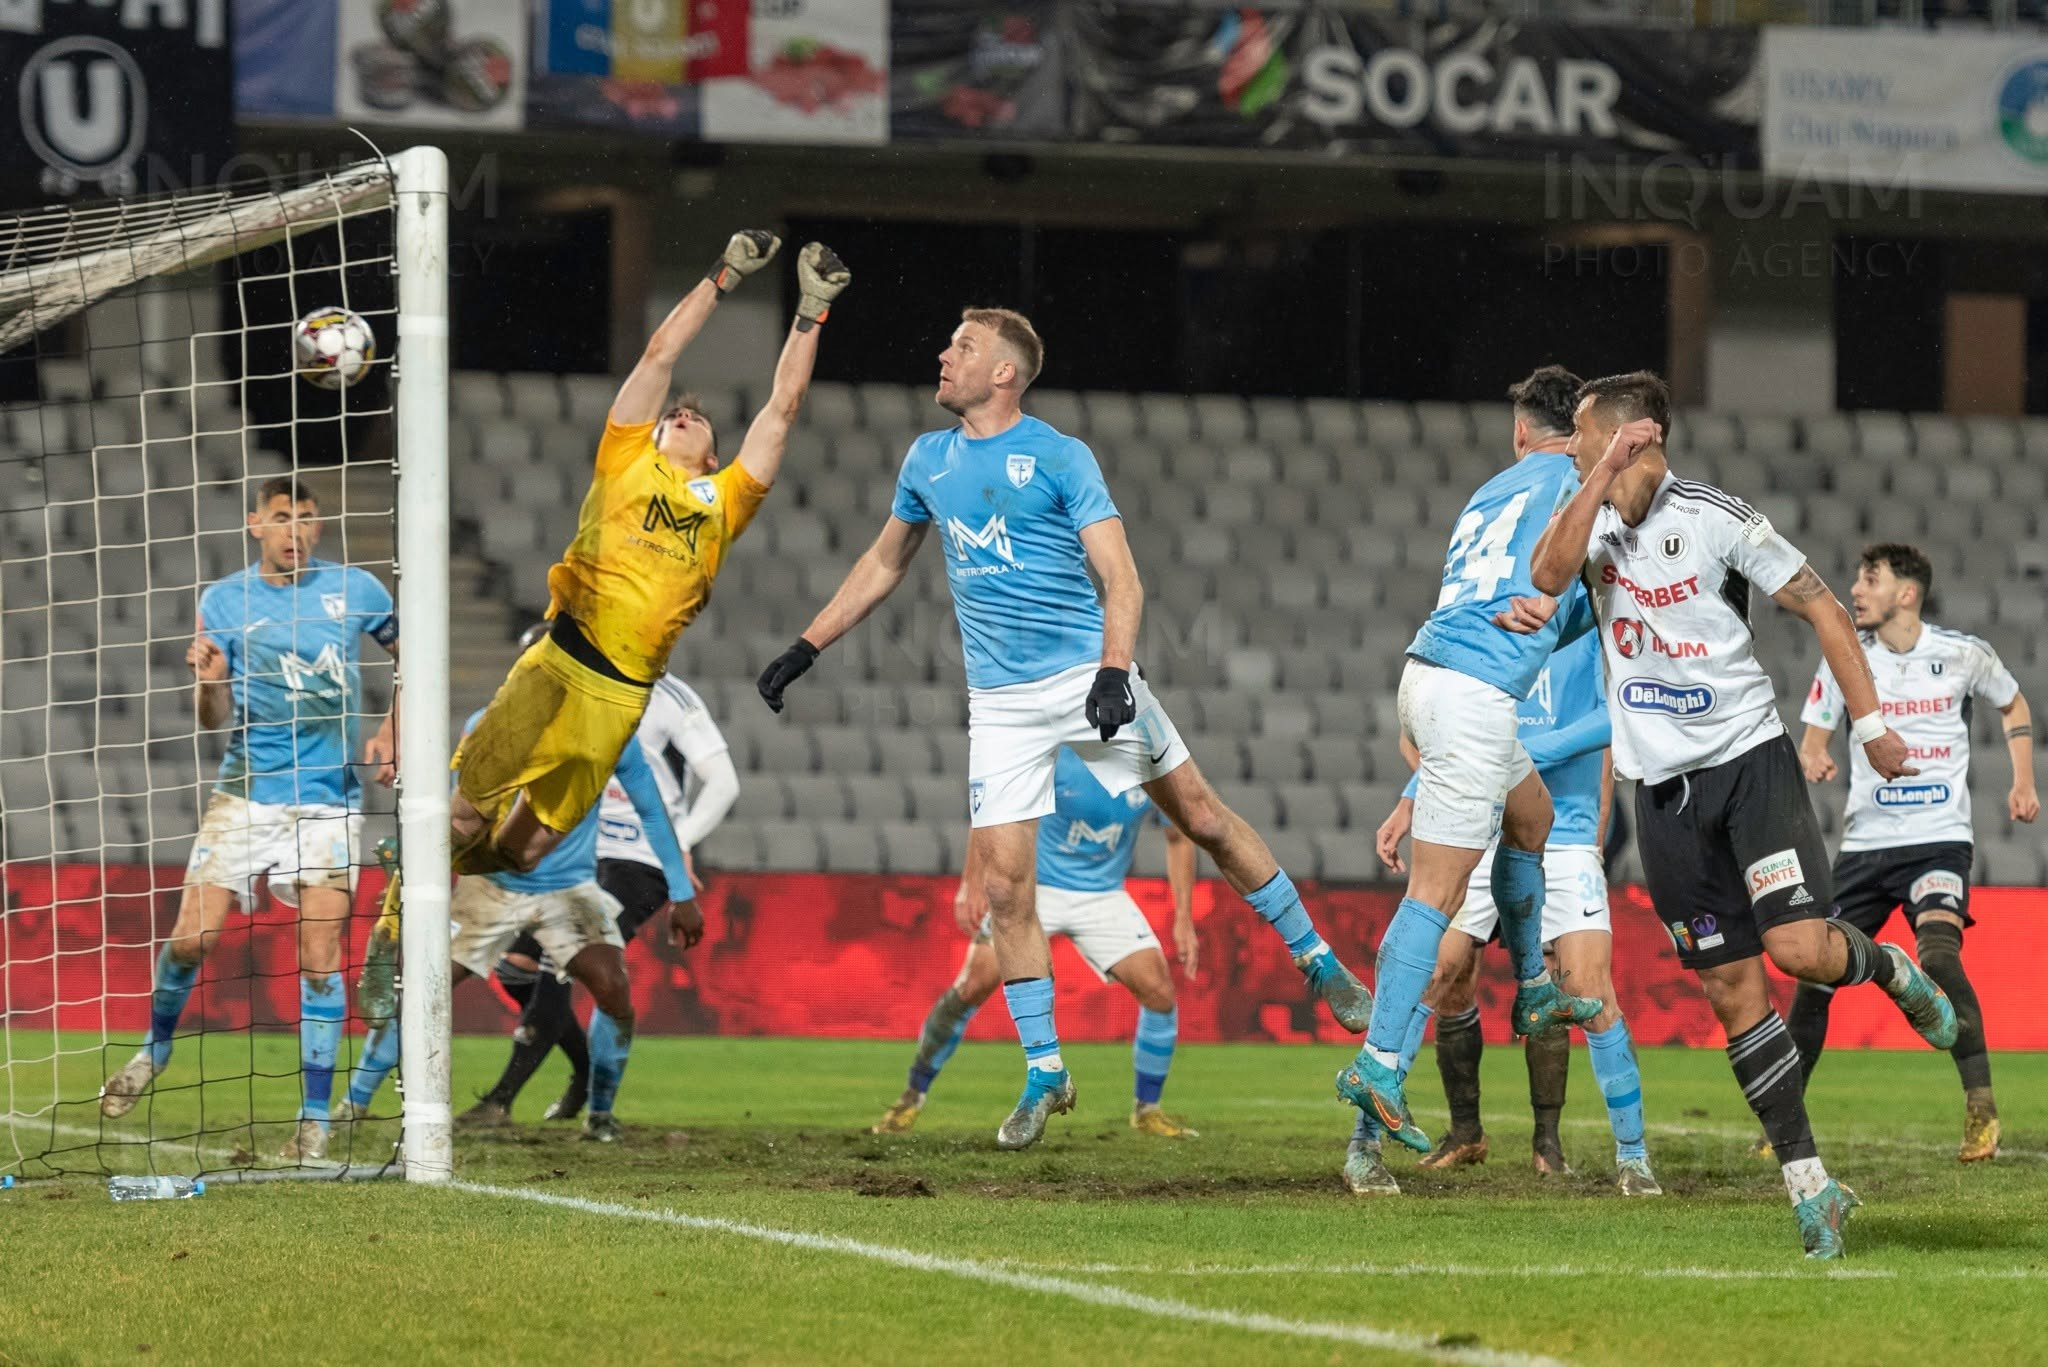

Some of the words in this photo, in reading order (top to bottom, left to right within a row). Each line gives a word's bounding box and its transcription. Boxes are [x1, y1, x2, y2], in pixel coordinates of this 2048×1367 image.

[1302, 47, 1621, 137] SOCAR
[42, 60, 124, 162] U
[1436, 491, 1530, 609] 24
[1665, 538, 1679, 556] U
[956, 565, 1009, 577] METROPOLA
[1011, 562, 1024, 571] TV
[1881, 696, 1953, 716] PERBET
[1906, 746, 1951, 759] RUM
[1762, 858, 1793, 875] CLINICA
[1788, 895, 1814, 906] adidas
